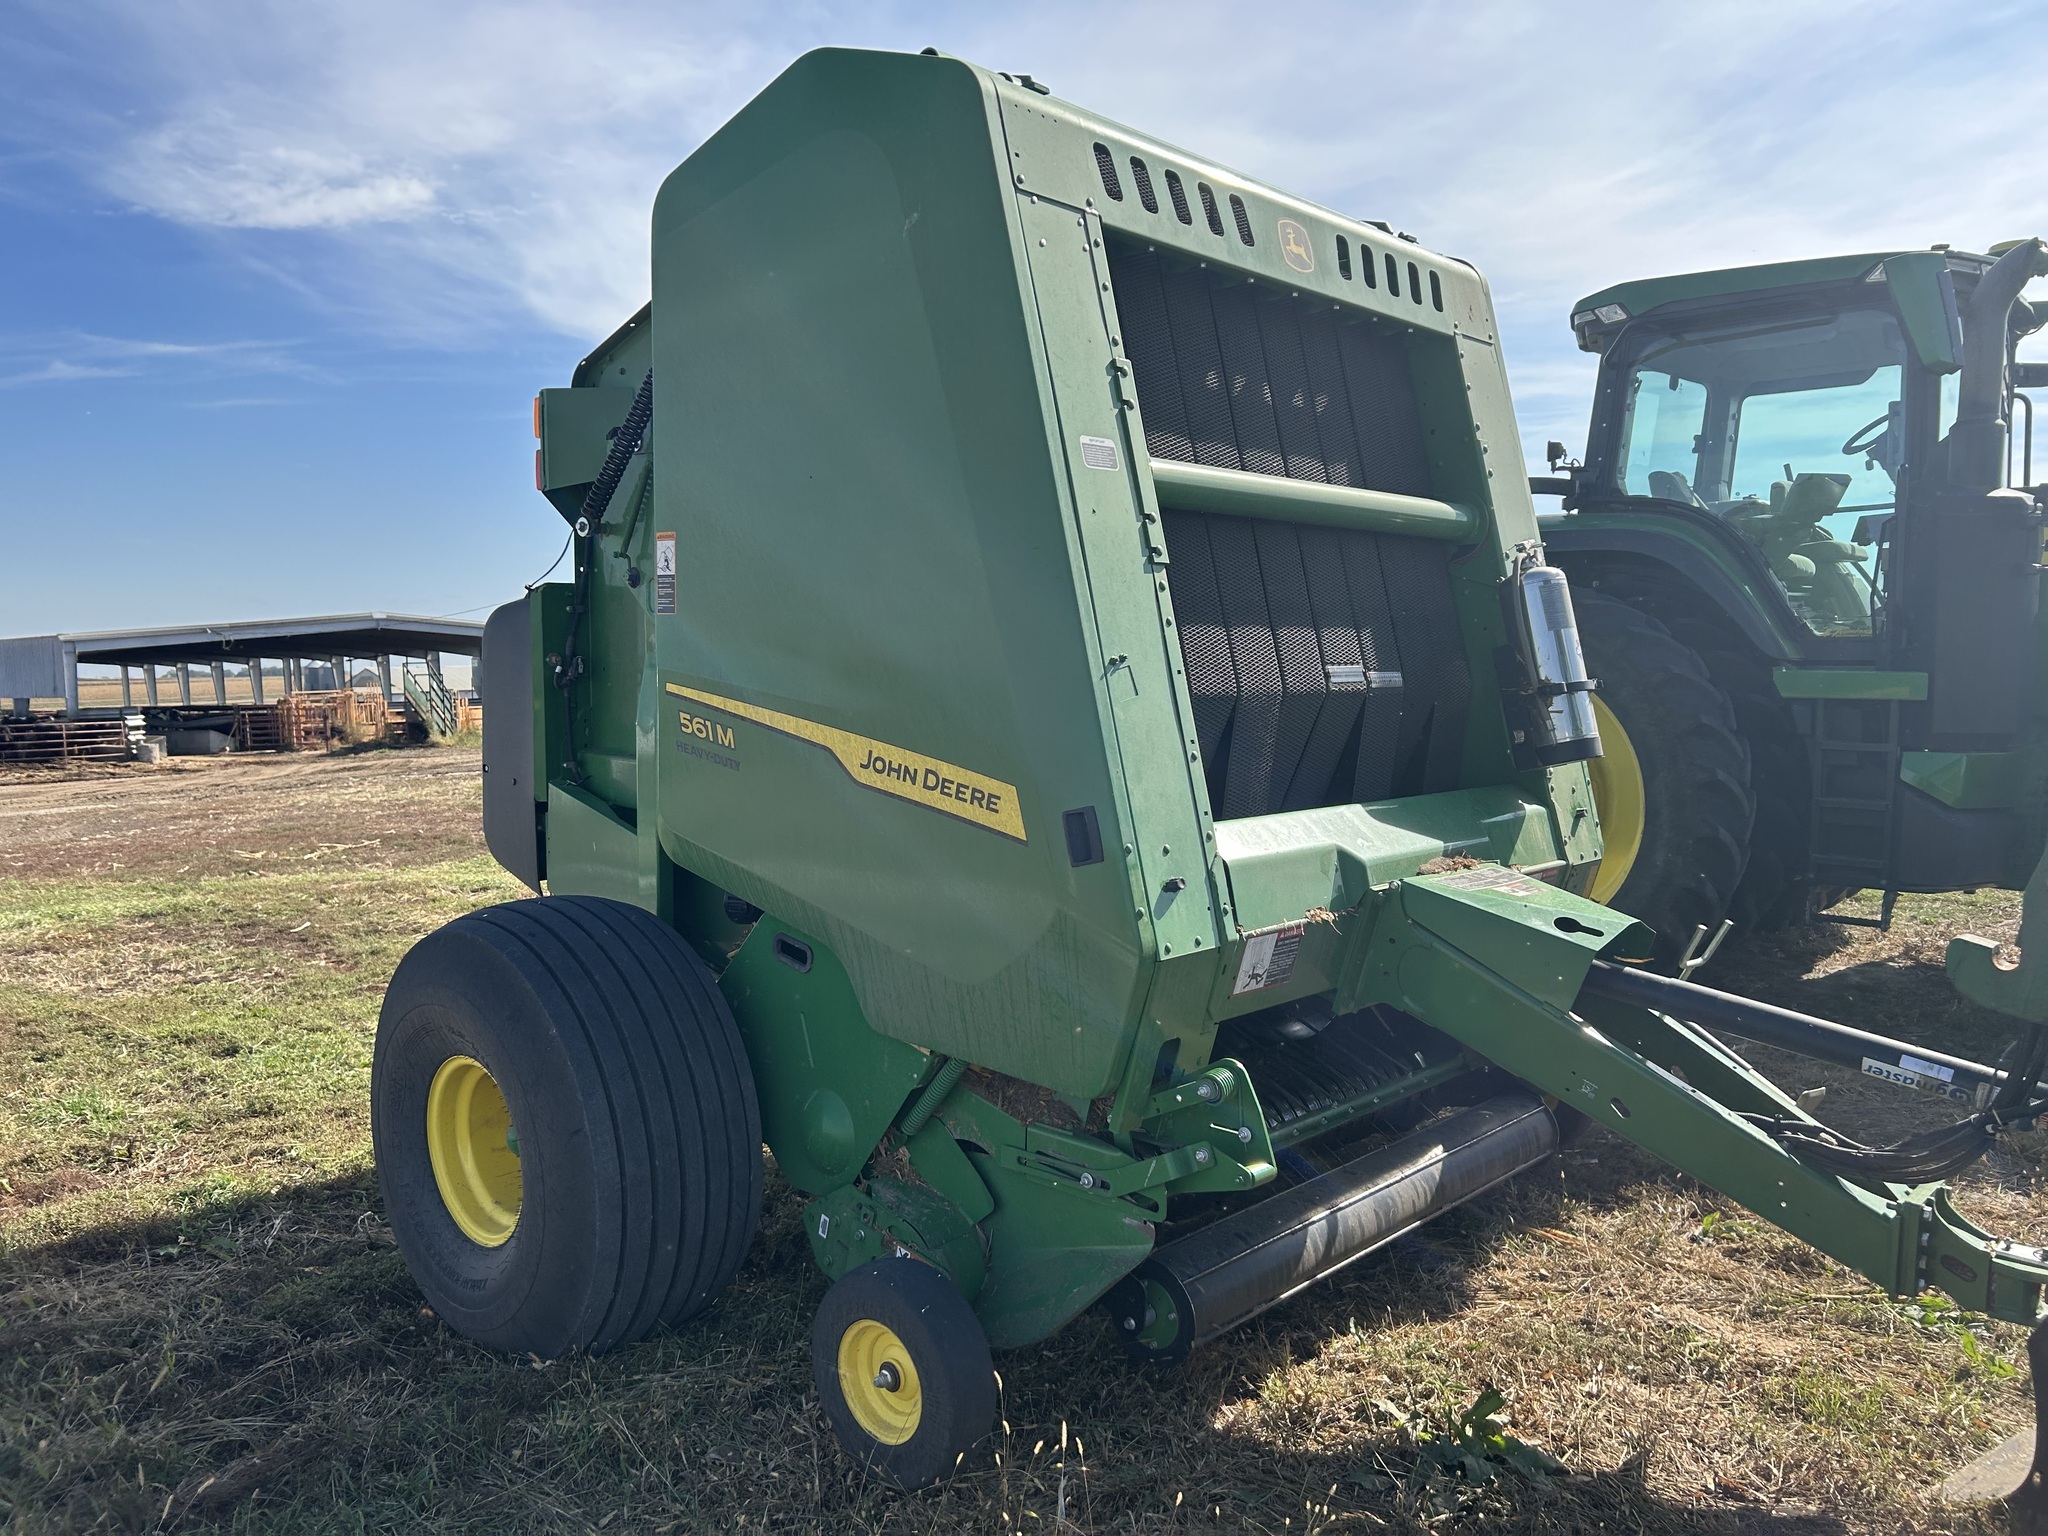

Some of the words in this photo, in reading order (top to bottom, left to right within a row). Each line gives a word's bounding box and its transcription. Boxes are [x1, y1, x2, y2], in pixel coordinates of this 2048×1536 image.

[676, 740, 741, 772] HEAVY-DUTY
[859, 750, 917, 786] JOHN
[923, 768, 1002, 814] DEERE
